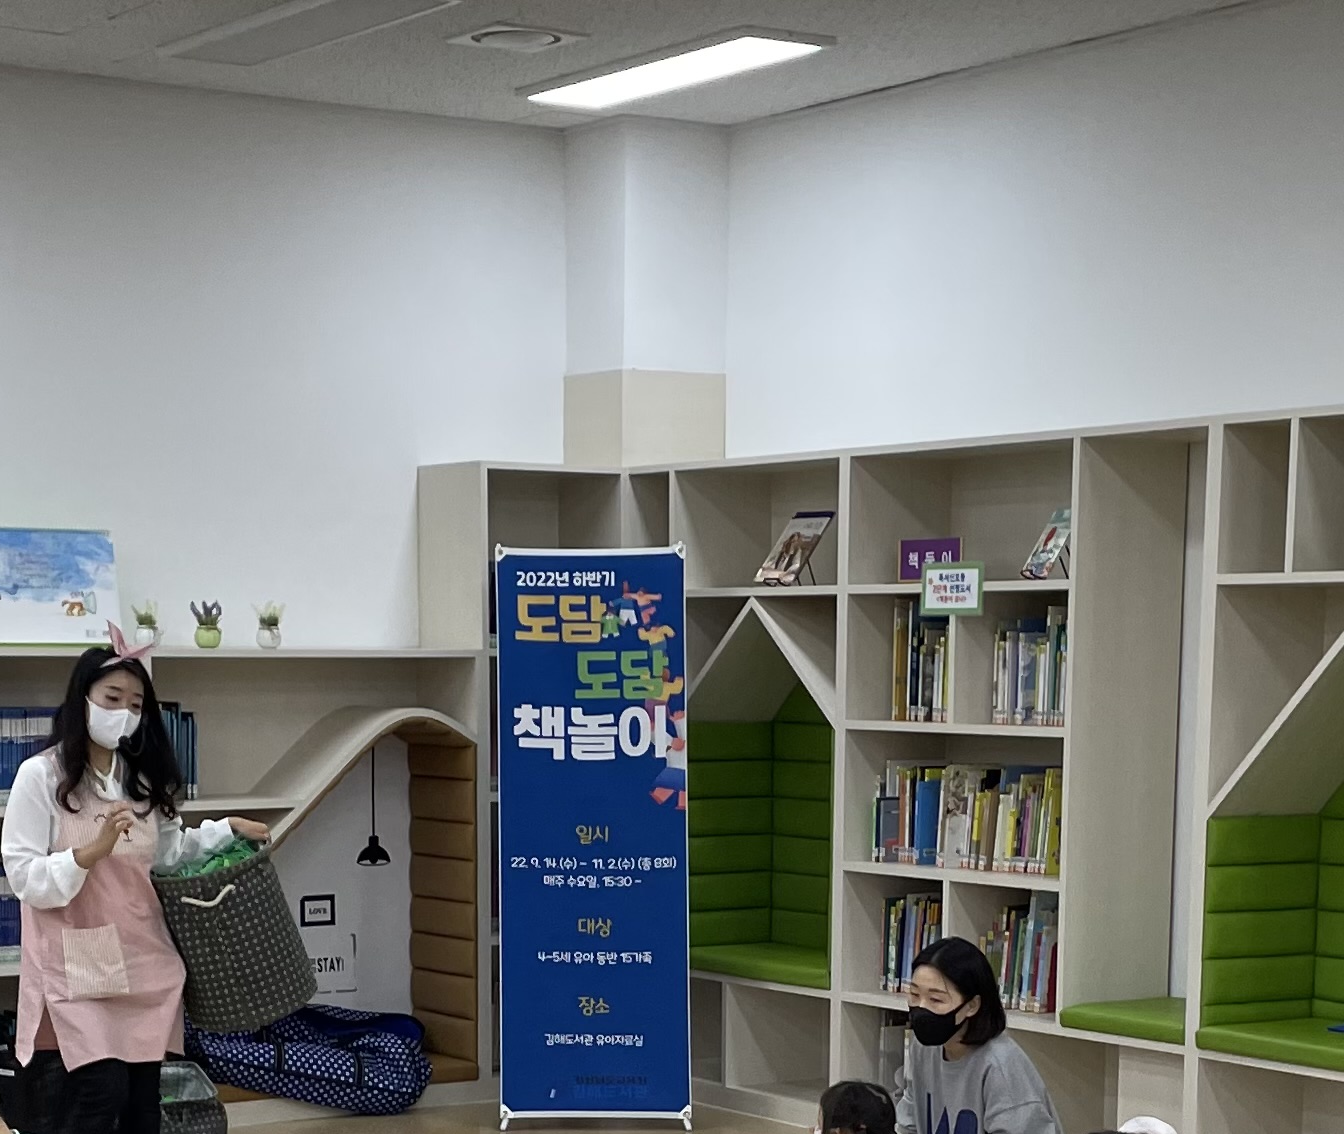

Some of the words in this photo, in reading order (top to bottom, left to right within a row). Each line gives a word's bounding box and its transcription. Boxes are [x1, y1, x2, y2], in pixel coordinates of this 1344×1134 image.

[516, 571, 570, 587] 2022년
[573, 571, 615, 587] 하반기
[515, 594, 607, 643] 도담
[574, 650, 669, 700] 도담
[575, 825, 609, 844] 일시
[510, 856, 528, 868] 22.
[530, 856, 541, 868] 9.
[543, 875, 565, 888] 매주
[602, 876, 633, 887] 15:30
[577, 918, 612, 938] 대상
[574, 951, 594, 964] 유아
[597, 951, 617, 965] 동반
[578, 996, 610, 1016] 장소
